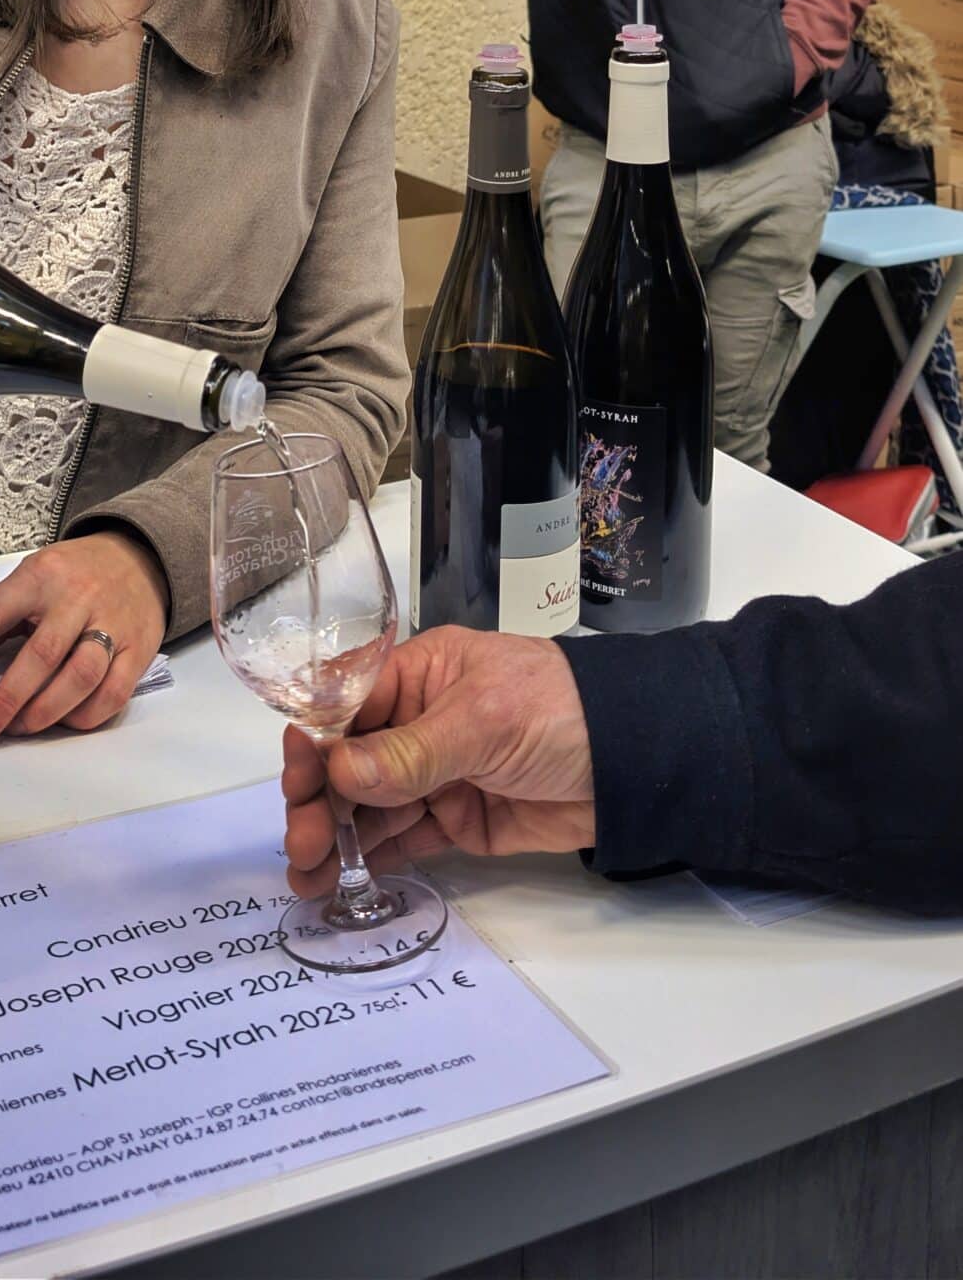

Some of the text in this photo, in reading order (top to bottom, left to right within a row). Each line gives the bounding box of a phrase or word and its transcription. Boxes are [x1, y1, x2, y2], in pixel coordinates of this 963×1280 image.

[592, 582, 627, 597] PERRET
[46, 915, 188, 959] Condrieu
[192, 896, 262, 924] 2024
[109, 950, 214, 986] Rouge
[218, 930, 289, 960] 2023
[71, 1022, 278, 1093] Merlot-Syrah
[280, 1001, 356, 1035] 2023
[410, 978, 445, 1000] 11
[451, 970, 477, 988] €
[101, 986, 234, 1031] Viognier
[240, 967, 314, 997] 2024
[27, 1164, 75, 1187] 42410
[76, 1136, 170, 1175] CHAVANAY
[280, 1052, 476, 1116] contact@andreperret.com
[81, 1136, 115, 1157] AOP
[118, 1131, 135, 1146] St
[139, 1114, 194, 1141] Joseph
[206, 1102, 234, 1119] IGP
[237, 1087, 297, 1111] Collines
[296, 1058, 403, 1094] Rhodaniennes
[35, 1212, 49, 1224] ne
[101, 1193, 121, 1208] pas
[146, 1177, 172, 1193] droit
[173, 1172, 188, 1185] de
[249, 1146, 274, 1164] pour
[275, 1142, 289, 1154] un
[290, 1132, 317, 1150] achat
[359, 1115, 384, 1130] dans
[384, 1112, 399, 1124] un
